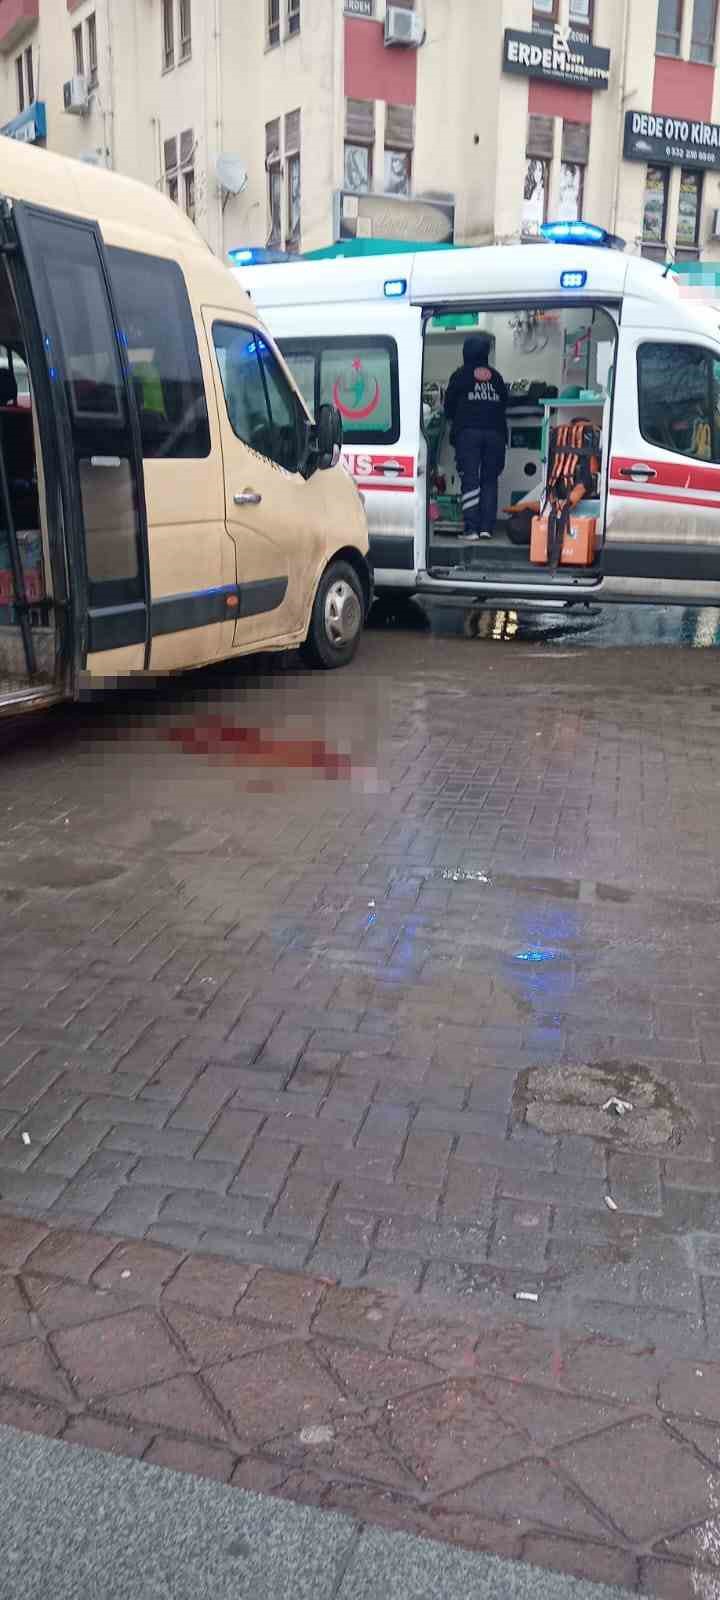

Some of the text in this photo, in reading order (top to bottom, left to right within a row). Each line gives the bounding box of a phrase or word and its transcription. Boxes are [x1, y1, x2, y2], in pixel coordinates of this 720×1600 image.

[507, 40, 566, 71] ERDEM
[632, 113, 664, 139] DEDE
[665, 119, 689, 141] OTO
[341, 454, 373, 475] NS
